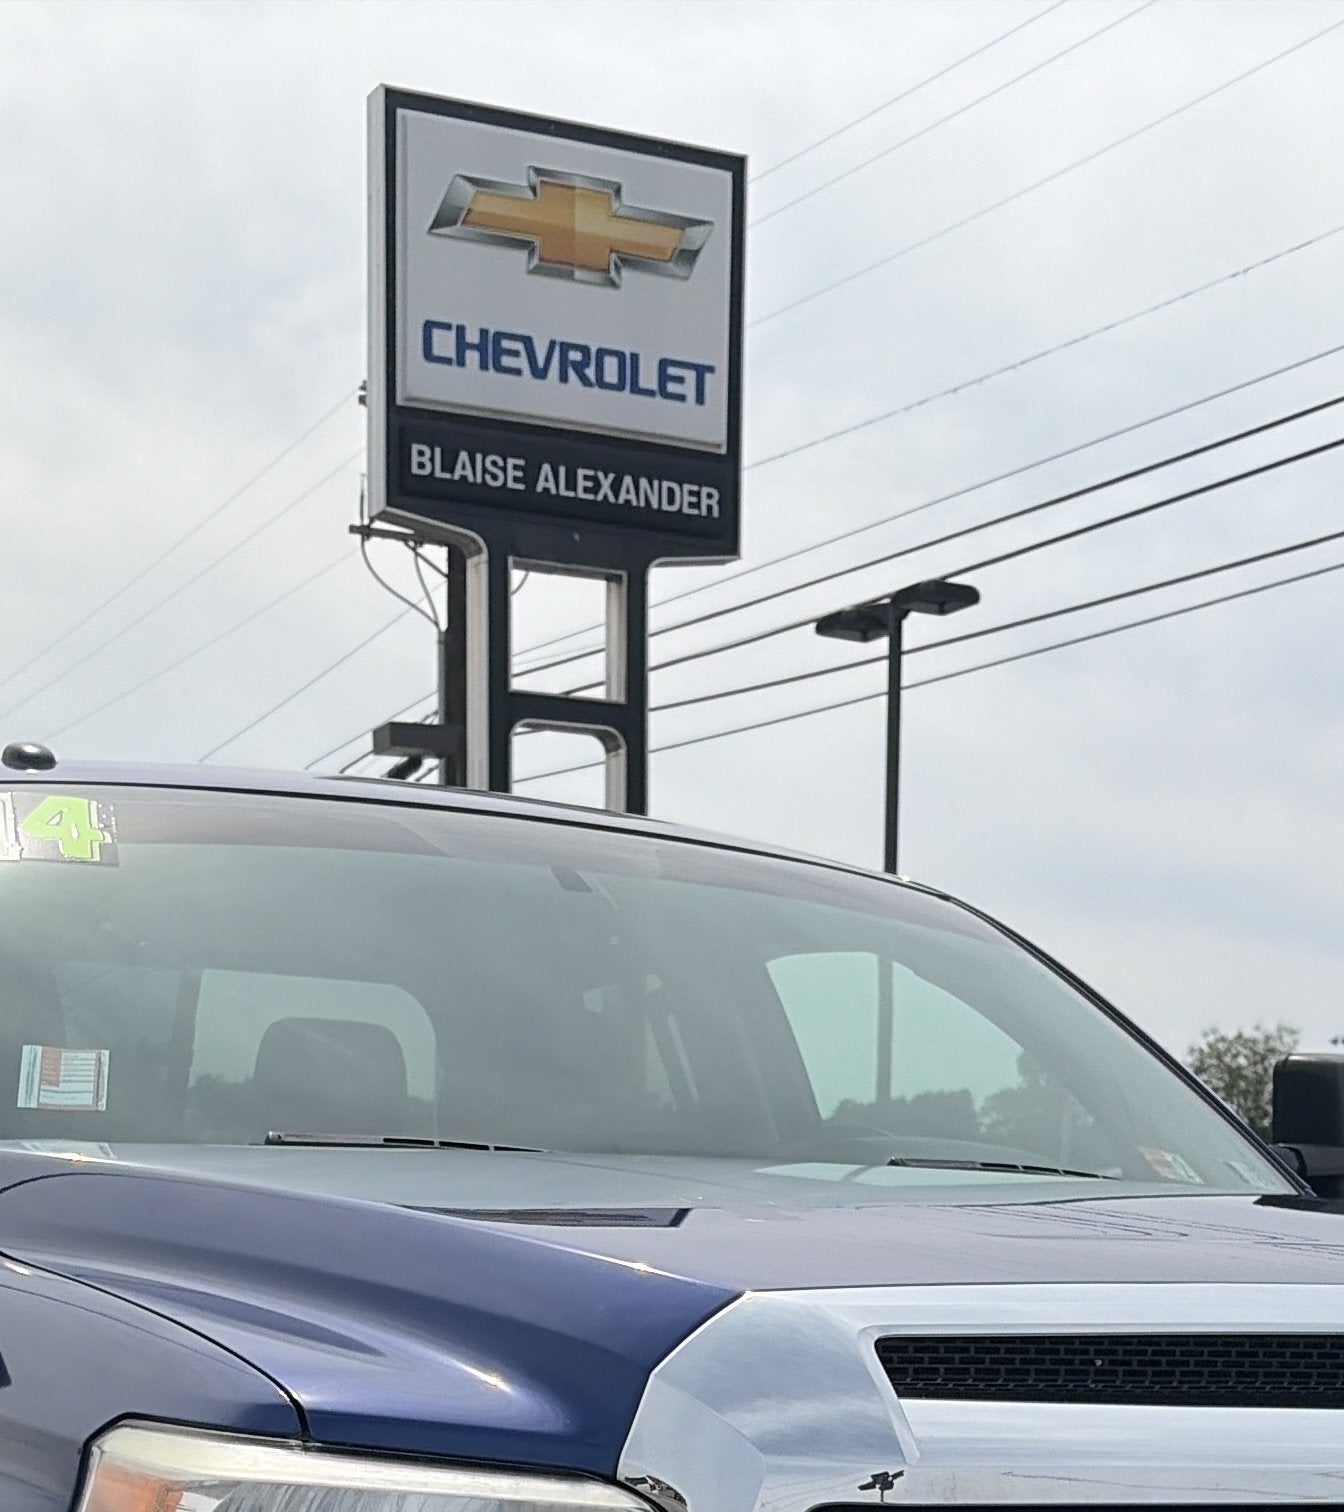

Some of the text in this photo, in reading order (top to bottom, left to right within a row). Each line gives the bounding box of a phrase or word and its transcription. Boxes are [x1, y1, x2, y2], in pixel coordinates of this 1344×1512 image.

[422, 319, 716, 406] CHEVROLET
[410, 443, 720, 518] BLAISE ALEXANDER
